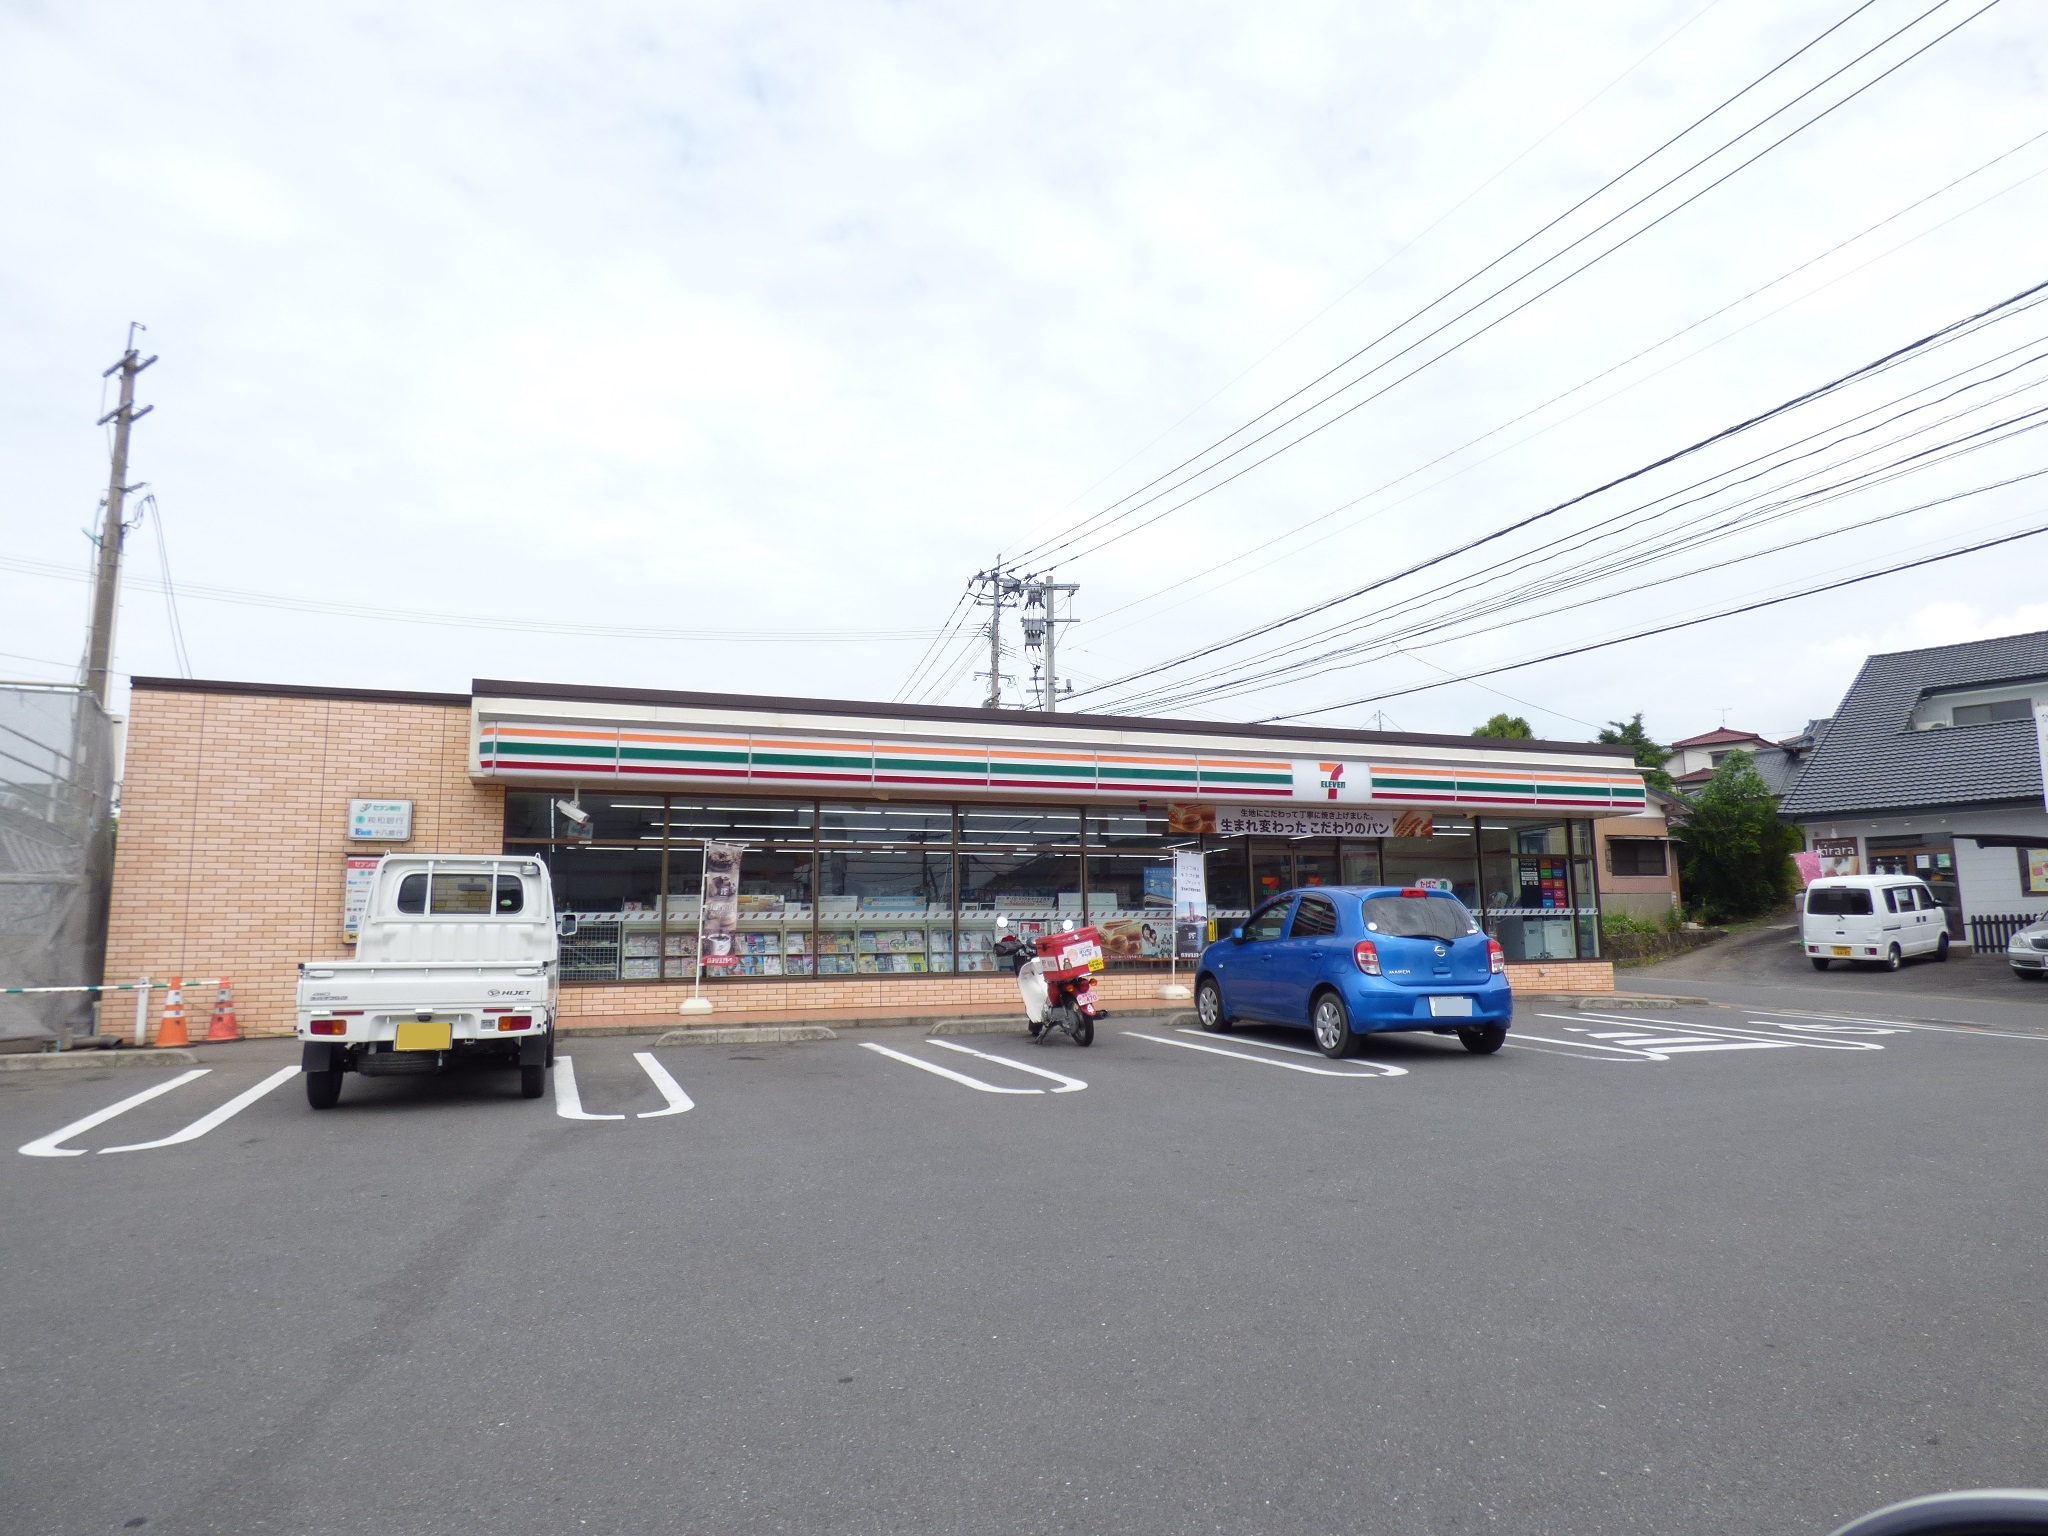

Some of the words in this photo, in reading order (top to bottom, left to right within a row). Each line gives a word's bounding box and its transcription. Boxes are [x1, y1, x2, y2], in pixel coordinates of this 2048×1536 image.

[1240, 808, 1374, 821] 生地にこだわって丁寧に焼き上げました。
[1221, 819, 1307, 834] 生まれ変わった
[1310, 821, 1390, 835] こだわりのパン
